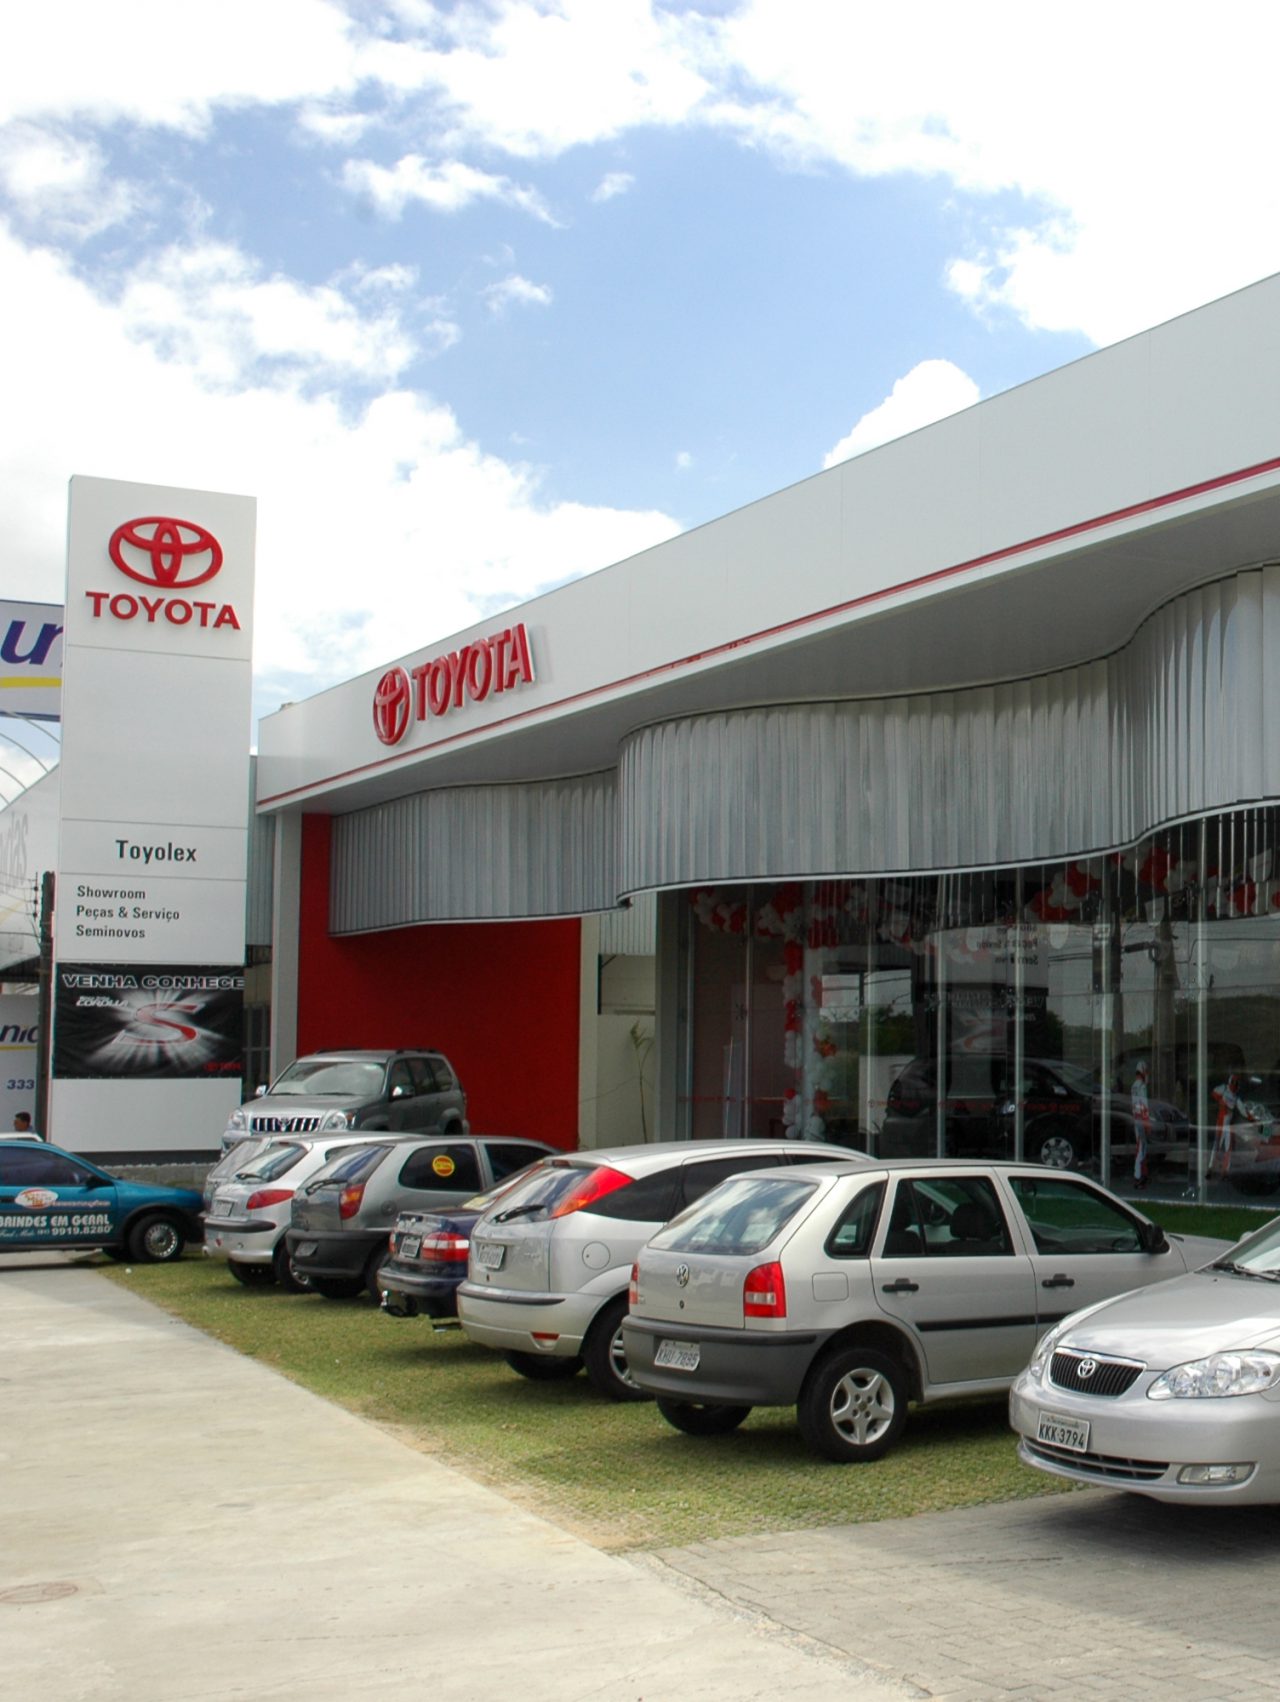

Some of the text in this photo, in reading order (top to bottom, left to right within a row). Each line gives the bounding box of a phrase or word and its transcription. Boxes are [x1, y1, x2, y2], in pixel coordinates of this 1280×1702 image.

[85, 591, 241, 630] TOYOTA
[411, 623, 535, 721] TOYOTA
[116, 839, 197, 865] Toyolex
[77, 885, 146, 899] Showroom
[76, 905, 180, 922] Peças & Serviço
[76, 924, 146, 938] Seminovos
[62, 974, 246, 990] VENHA CONHECE
[50, 1215, 68, 1226] EM
